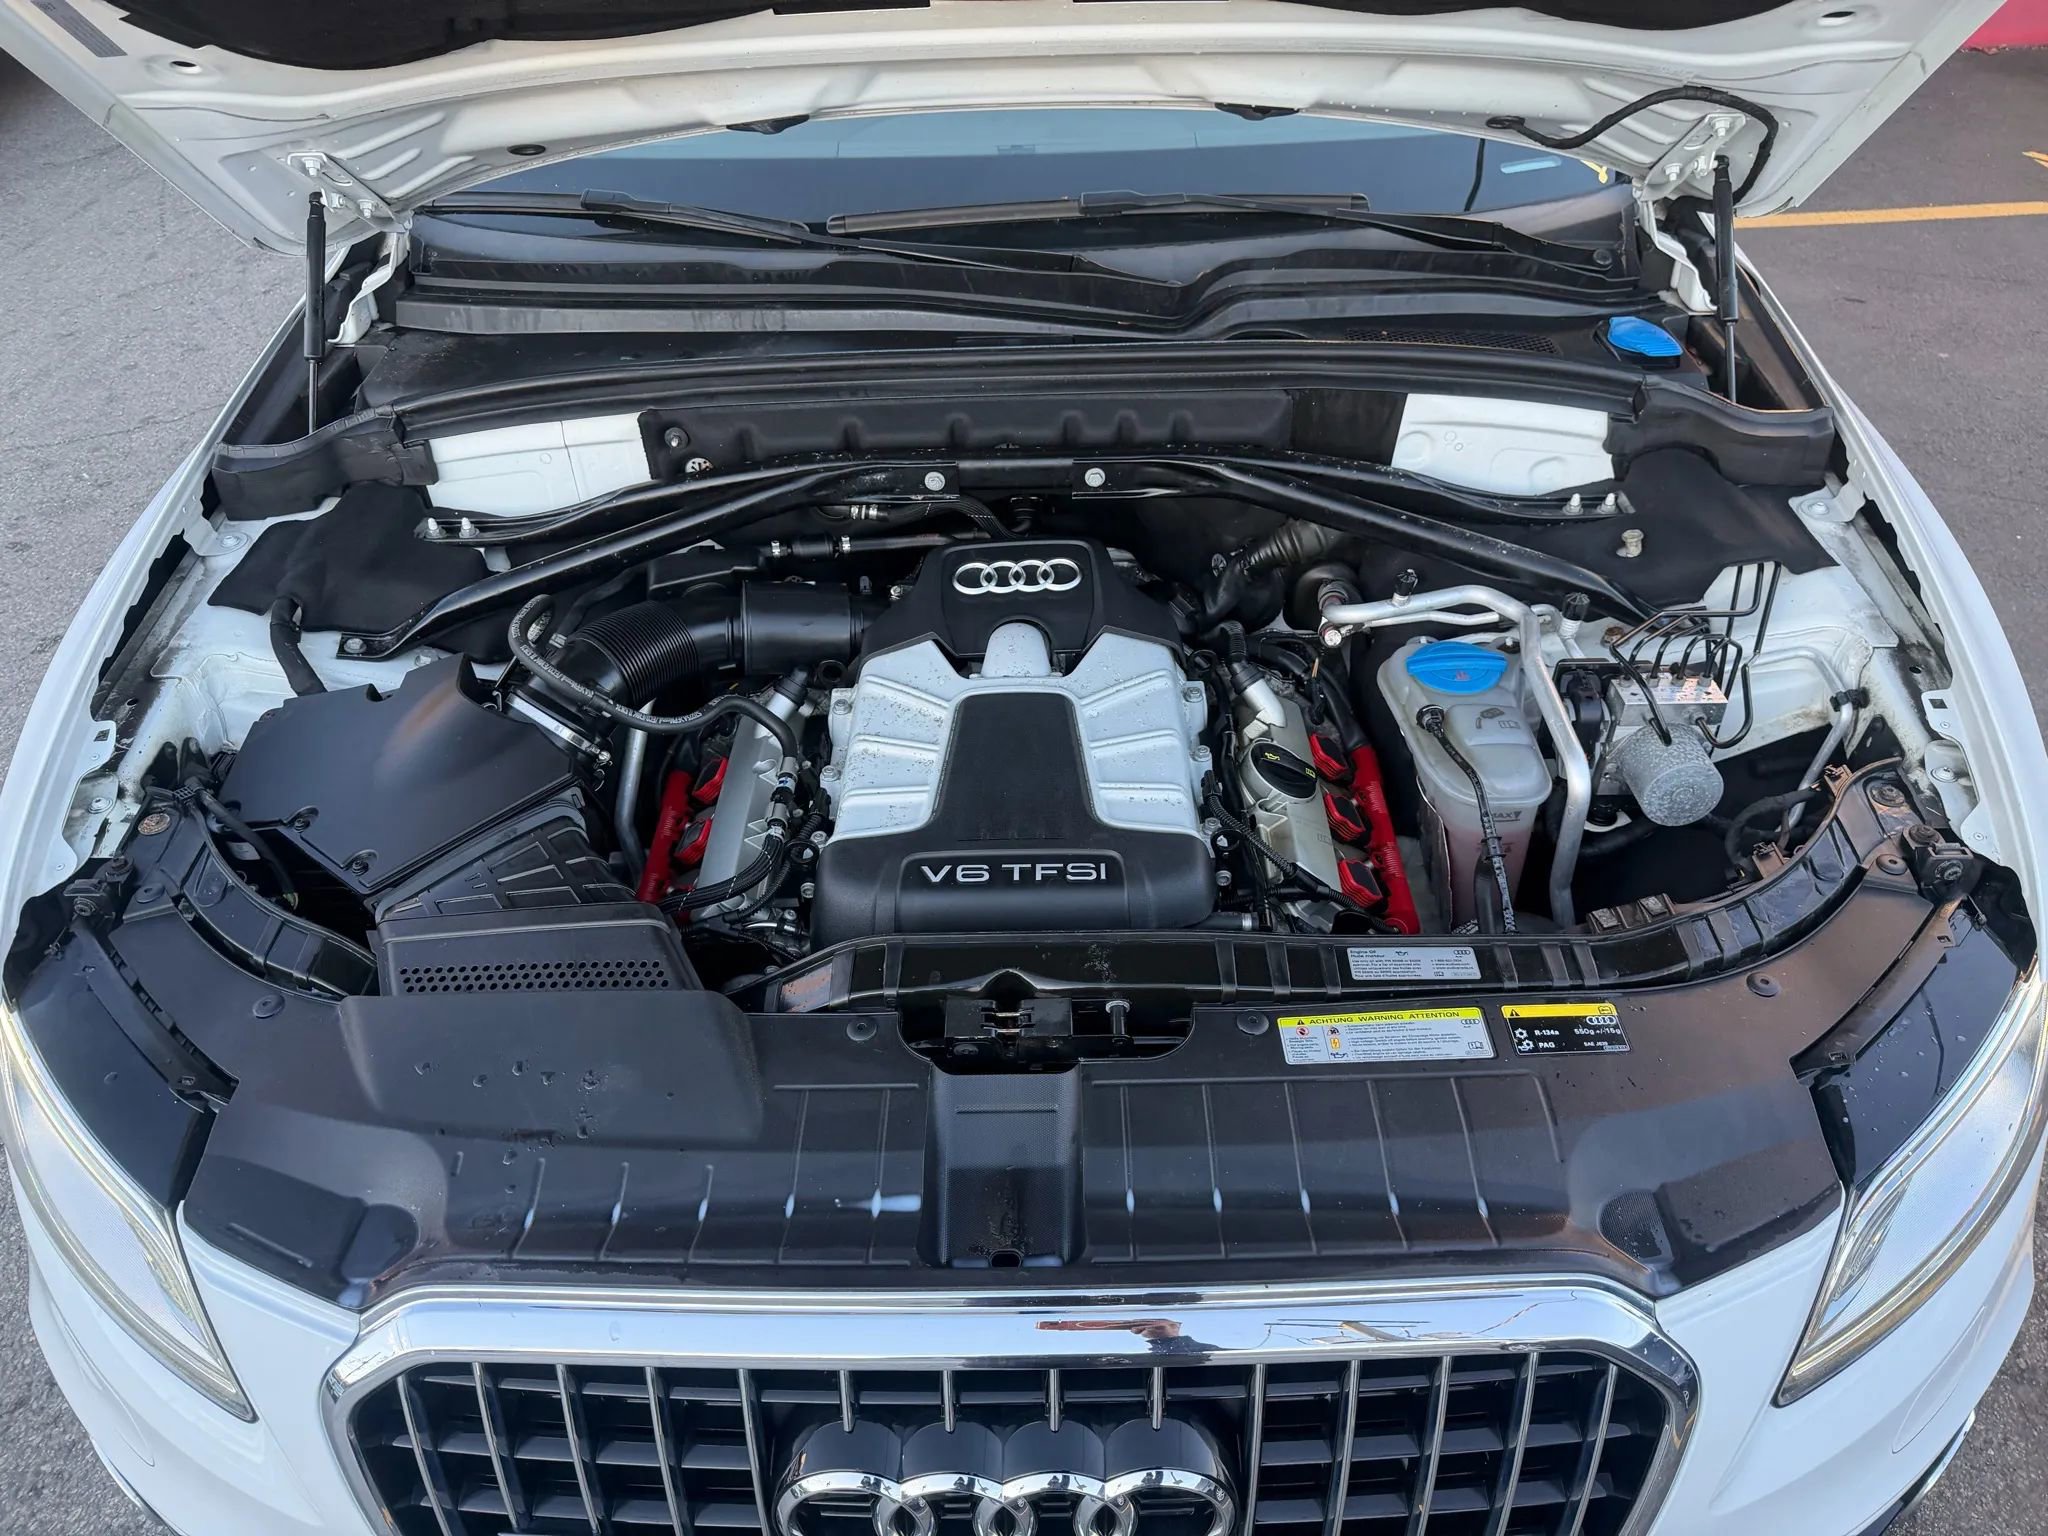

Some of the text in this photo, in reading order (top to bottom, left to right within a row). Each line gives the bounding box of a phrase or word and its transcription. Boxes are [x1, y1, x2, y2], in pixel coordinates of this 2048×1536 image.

[920, 863, 1107, 883] V6 TFSI
[1309, 1011, 1460, 1025] ACHTUNG WARNING ATTENTION
[1573, 1028, 1595, 1036] 550g
